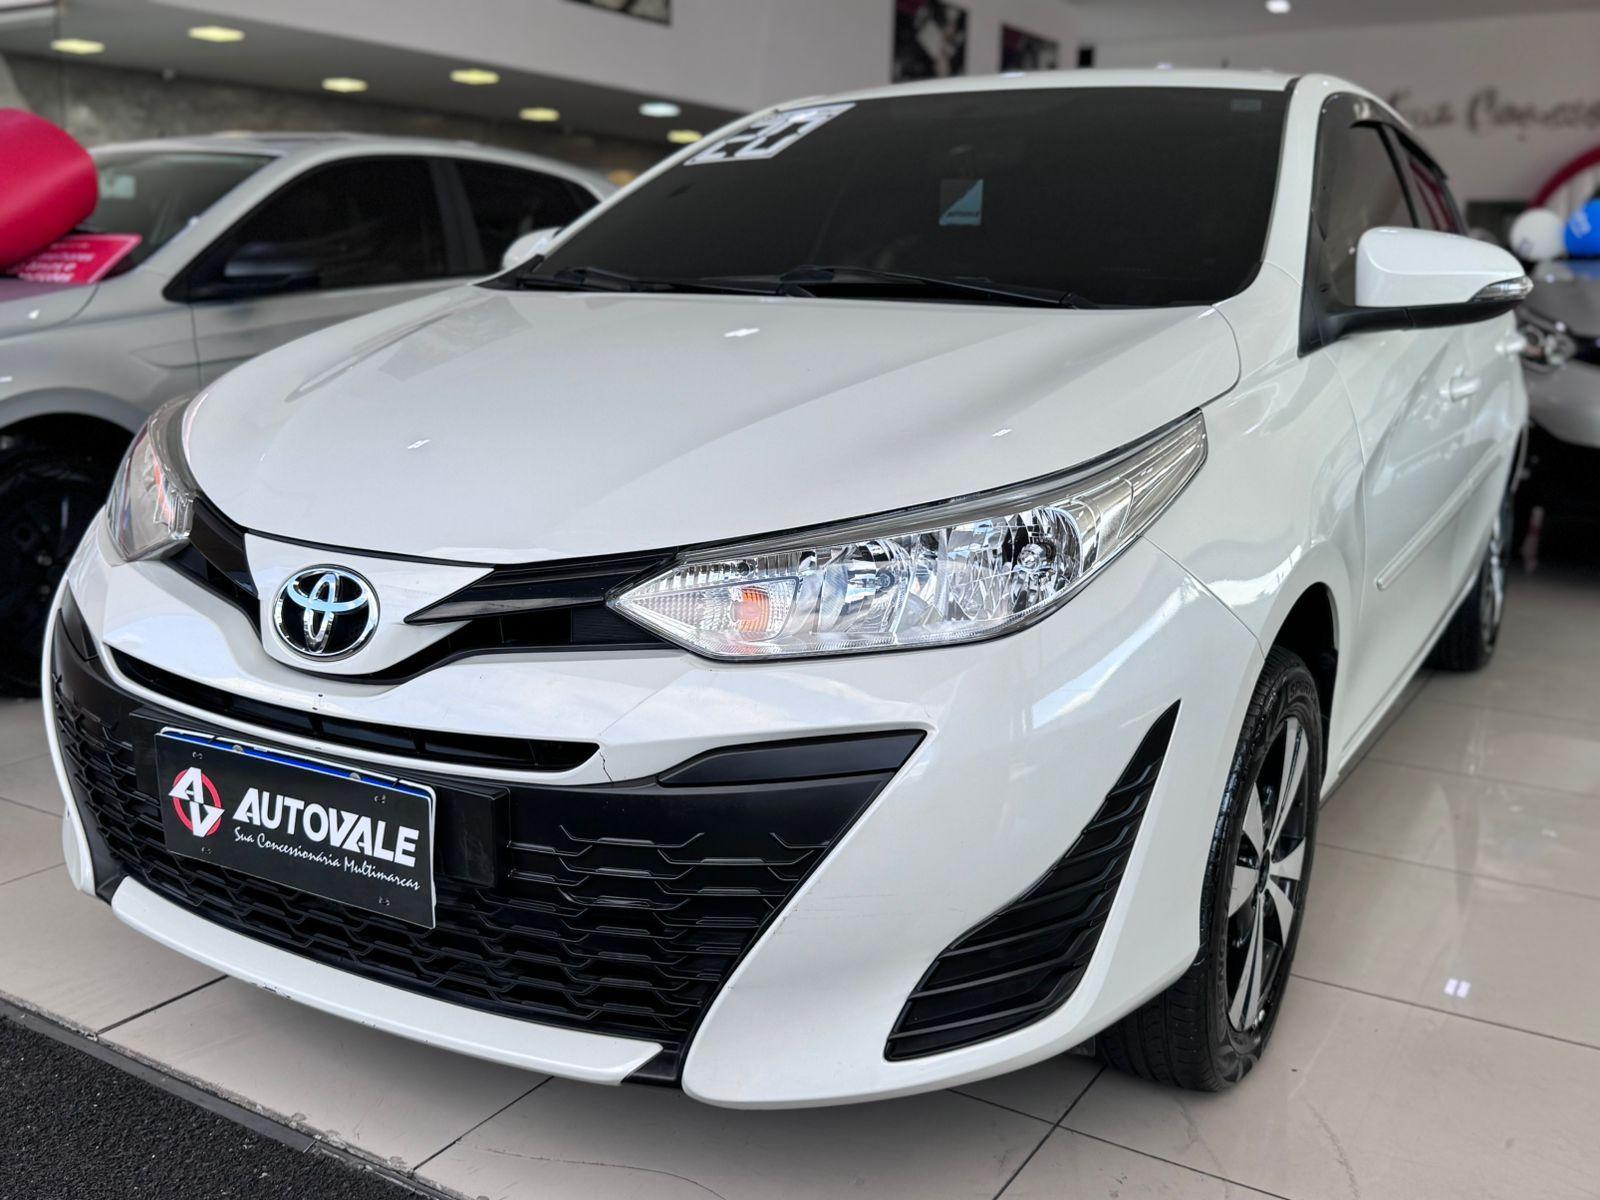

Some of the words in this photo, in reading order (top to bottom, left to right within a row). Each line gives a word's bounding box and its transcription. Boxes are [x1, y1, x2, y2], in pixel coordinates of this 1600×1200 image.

[233, 788, 419, 868] AUTOVALE
[234, 826, 255, 843] Sua
[343, 856, 421, 890] Multimarcas
